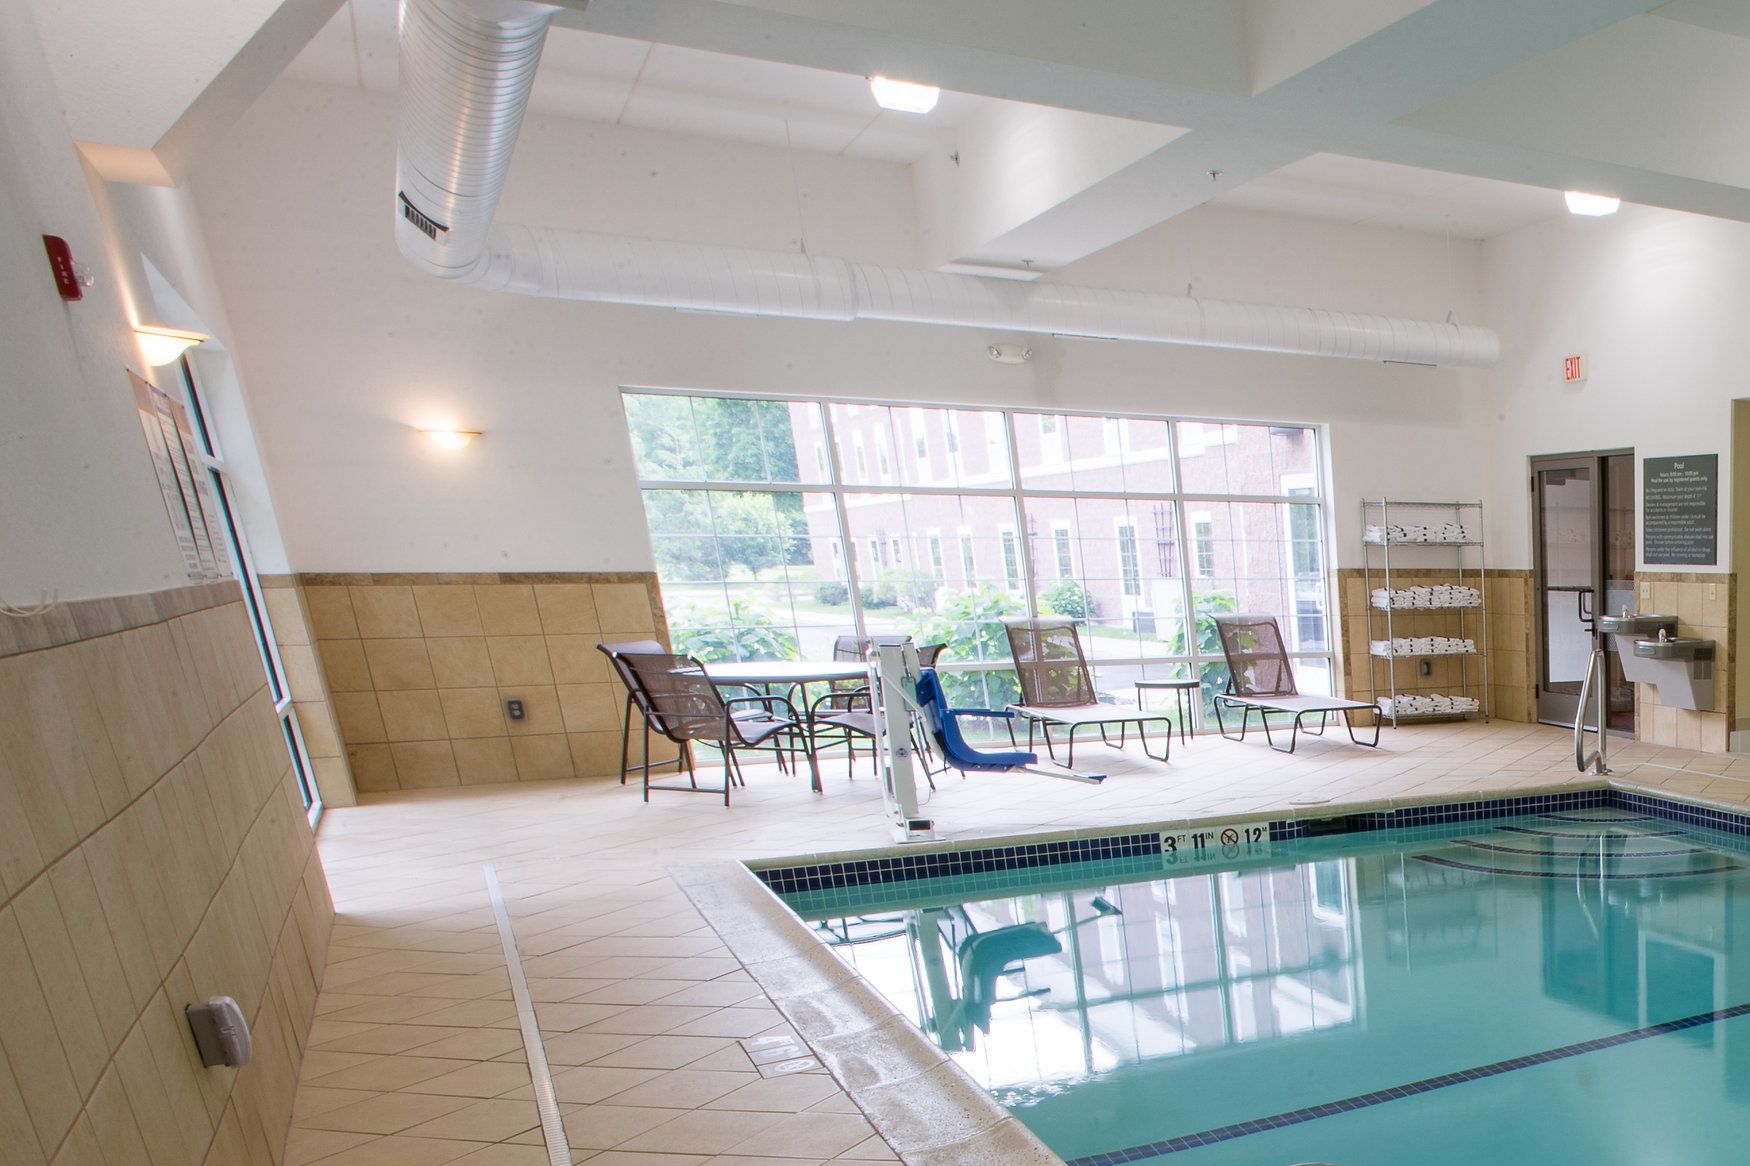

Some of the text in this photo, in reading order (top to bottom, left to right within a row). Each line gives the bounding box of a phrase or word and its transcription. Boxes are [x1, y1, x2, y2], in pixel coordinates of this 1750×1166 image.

[1565, 356, 1580, 380] EXIT
[1674, 462, 1684, 470] Pool
[1164, 836, 1177, 852] 3
[1191, 832, 1205, 849] 11
[1205, 832, 1214, 840] IN
